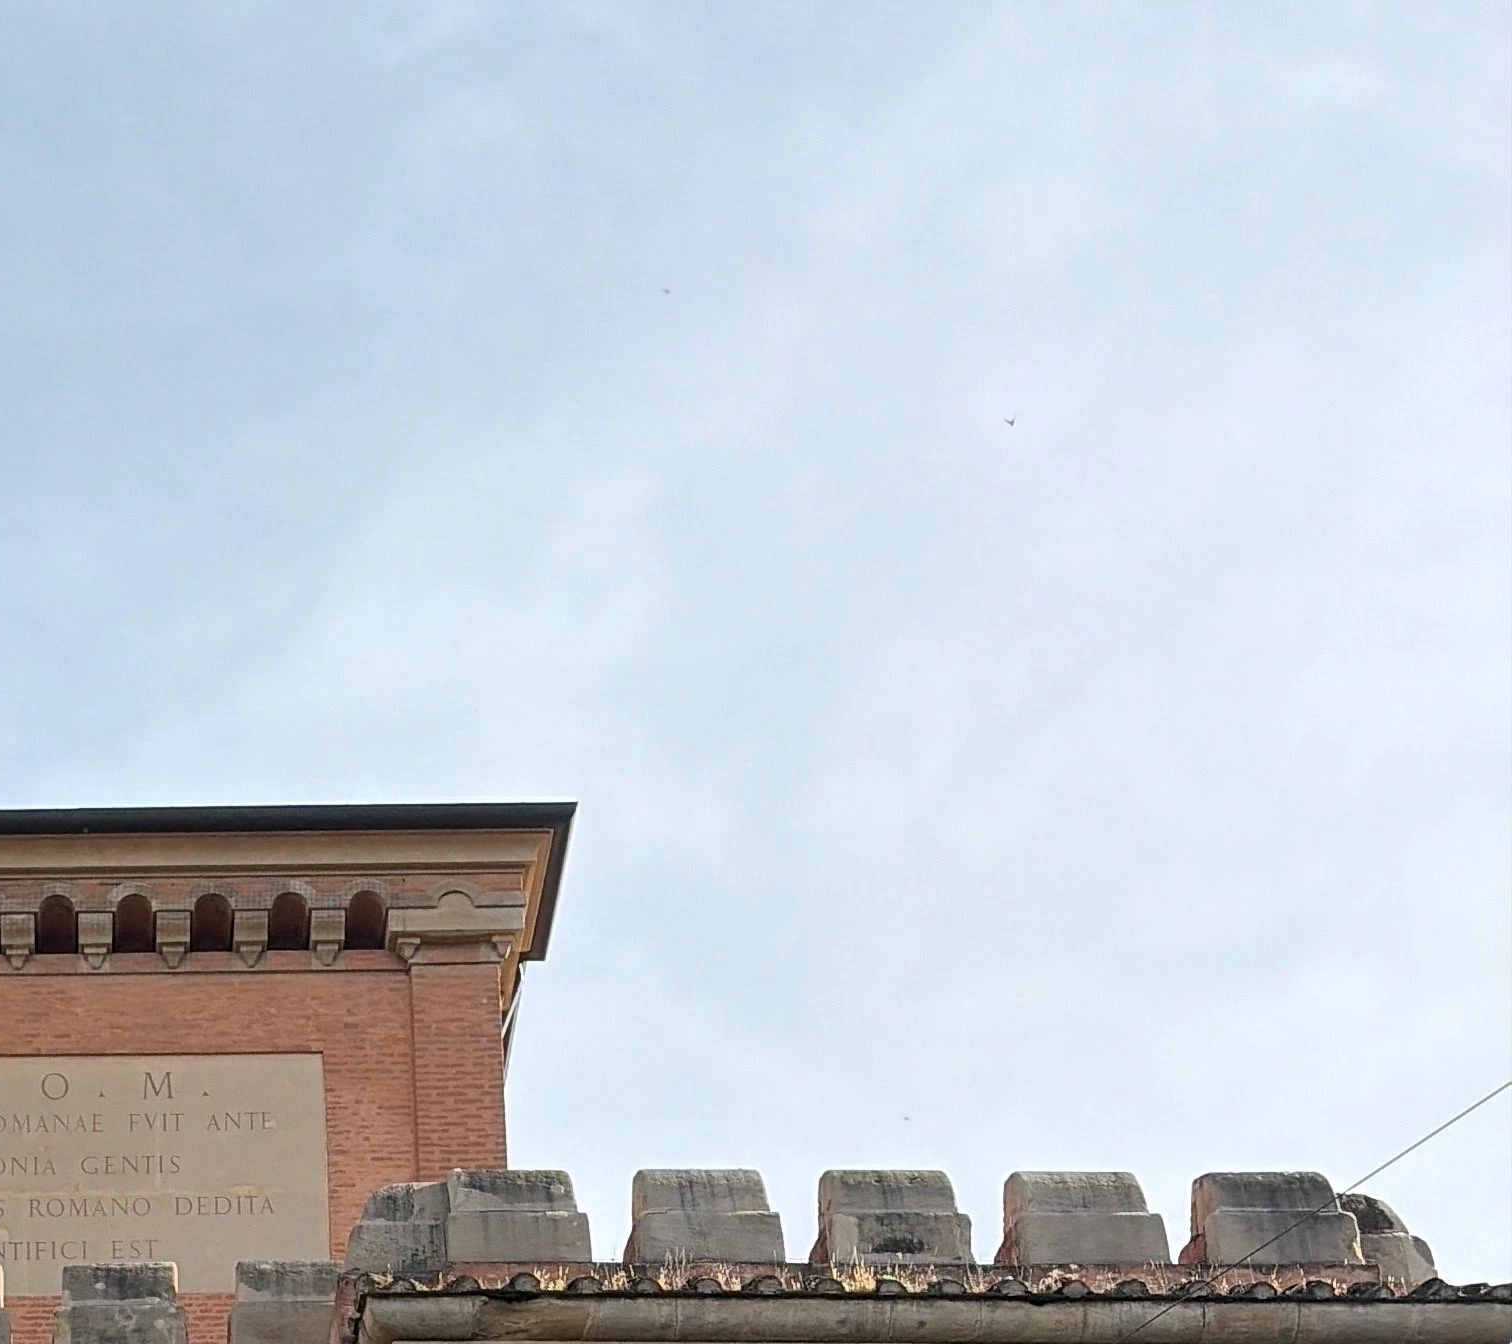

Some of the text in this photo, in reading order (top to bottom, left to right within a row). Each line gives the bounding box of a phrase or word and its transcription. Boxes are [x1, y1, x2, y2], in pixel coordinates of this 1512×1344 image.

[129, 1112, 185, 1133] FVIT
[205, 1111, 273, 1132] ANTE
[80, 1154, 182, 1176] GENTIS
[29, 1196, 153, 1219] ROMANO
[174, 1195, 277, 1217] DEDITA
[111, 1238, 161, 1261] EST
